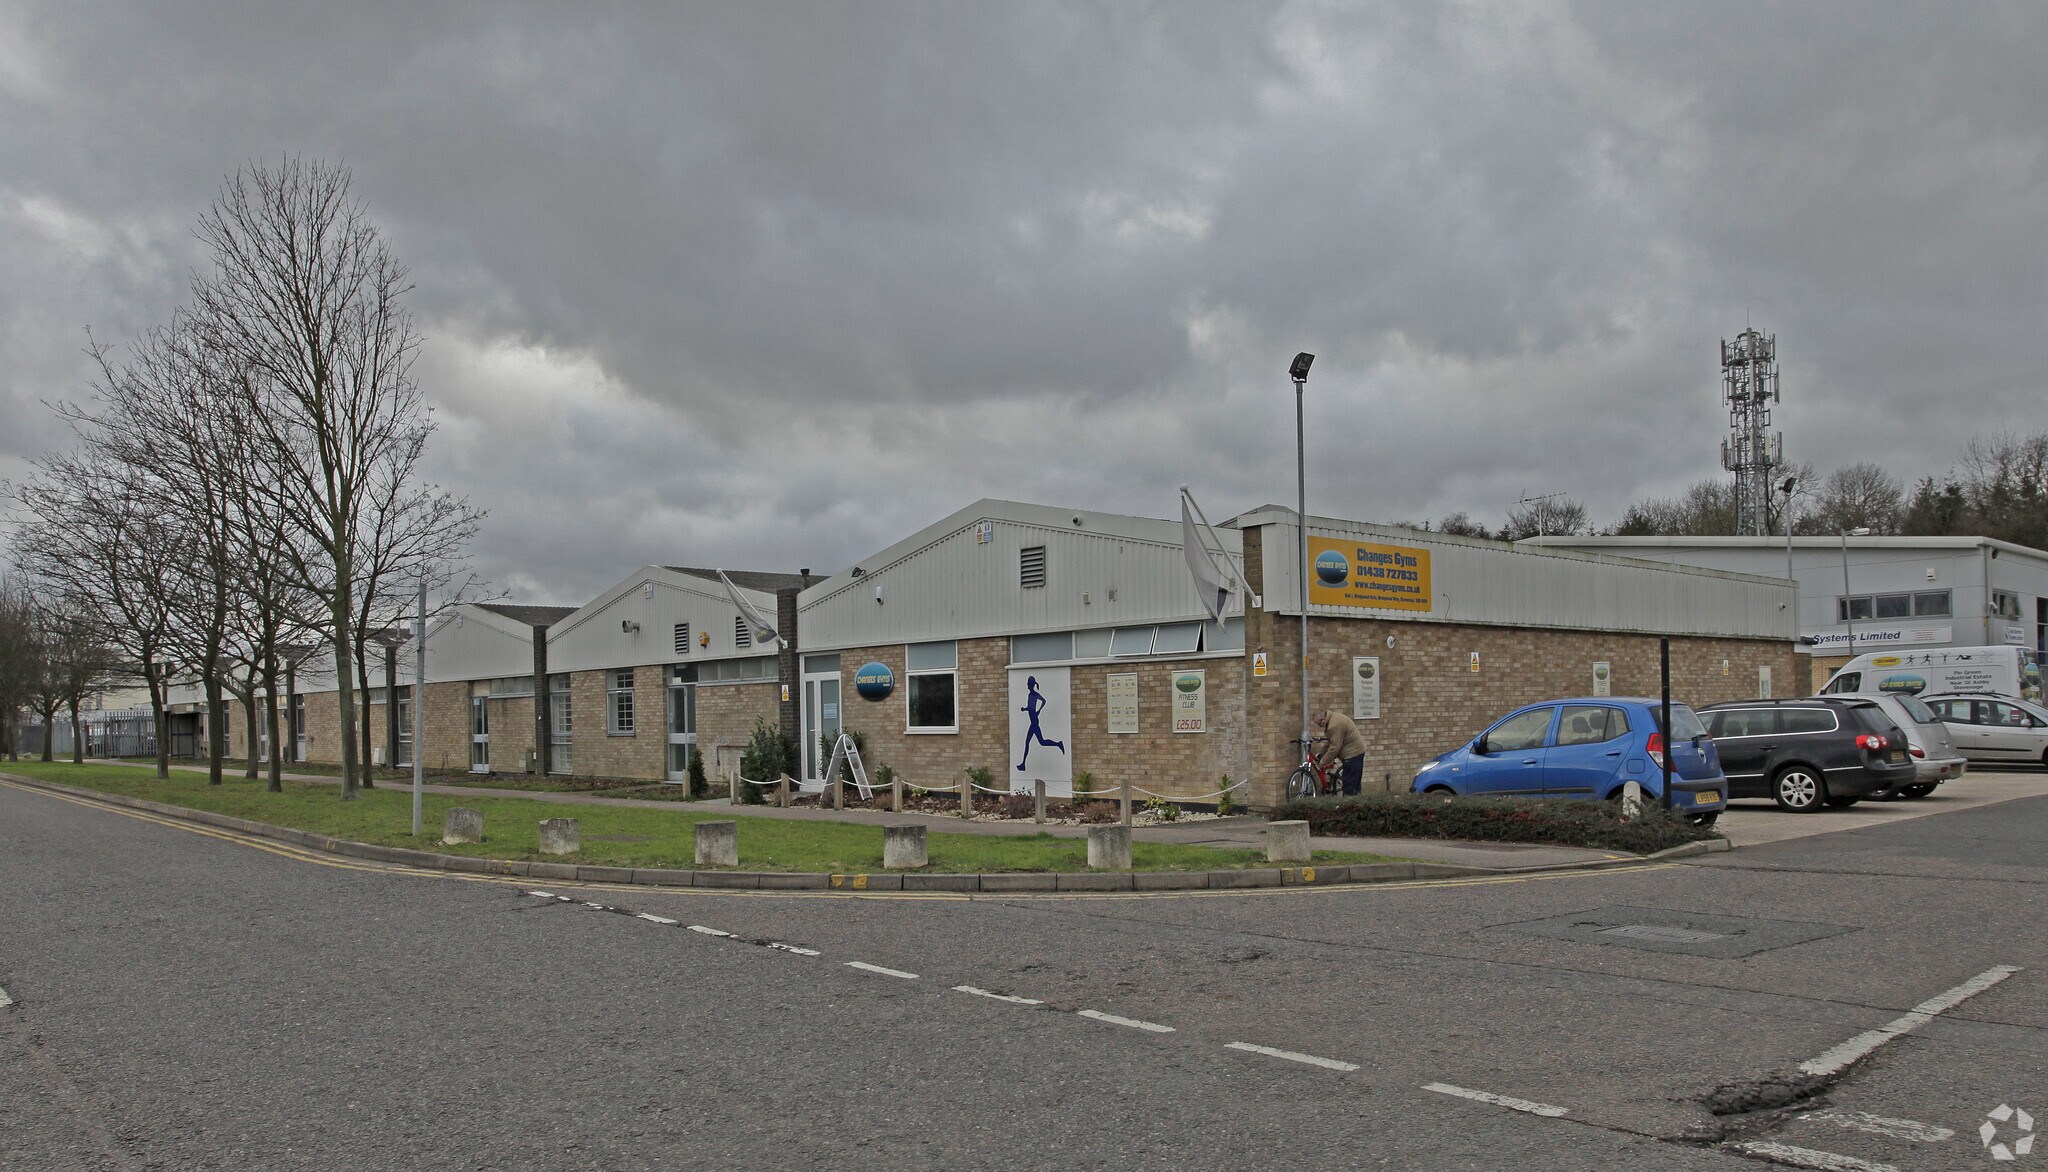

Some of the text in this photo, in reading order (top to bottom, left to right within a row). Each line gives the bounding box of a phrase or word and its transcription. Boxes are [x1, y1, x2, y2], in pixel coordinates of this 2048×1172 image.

[1357, 548, 1418, 568] Changes Gyms
[1357, 566, 1385, 578] 01438
[1354, 581, 1421, 594] www.changesgyms.co.uk
[1813, 634, 1857, 645] Systems
[1860, 631, 1901, 641] Limited
[1178, 693, 1198, 701] FITNESS
[1182, 701, 1195, 709] CLUB
